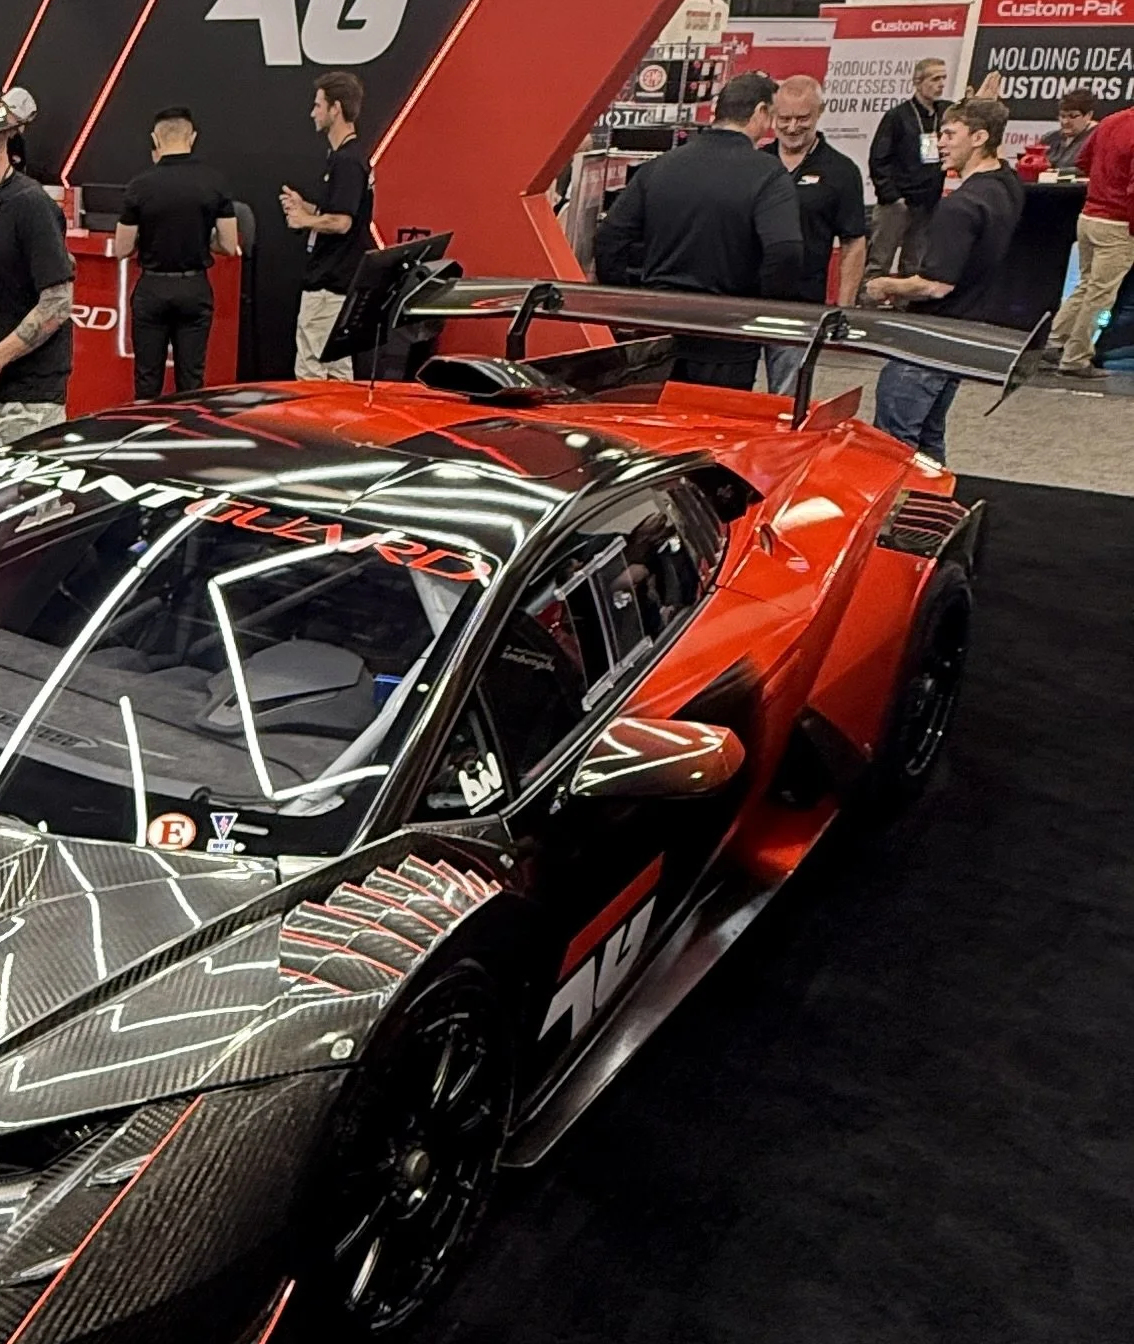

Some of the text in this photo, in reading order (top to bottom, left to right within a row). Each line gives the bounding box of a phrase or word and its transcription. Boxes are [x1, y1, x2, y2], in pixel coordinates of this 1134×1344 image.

[997, 0, 1126, 17] Custom-Pak
[871, 17, 958, 32] Custom-Pak
[988, 47, 1134, 71] MOLDING IDEA
[828, 60, 892, 76] PRODUCTS
[823, 79, 895, 94] PROCESSES
[999, 76, 1122, 100] USTOMERS
[158, 820, 185, 845] E
